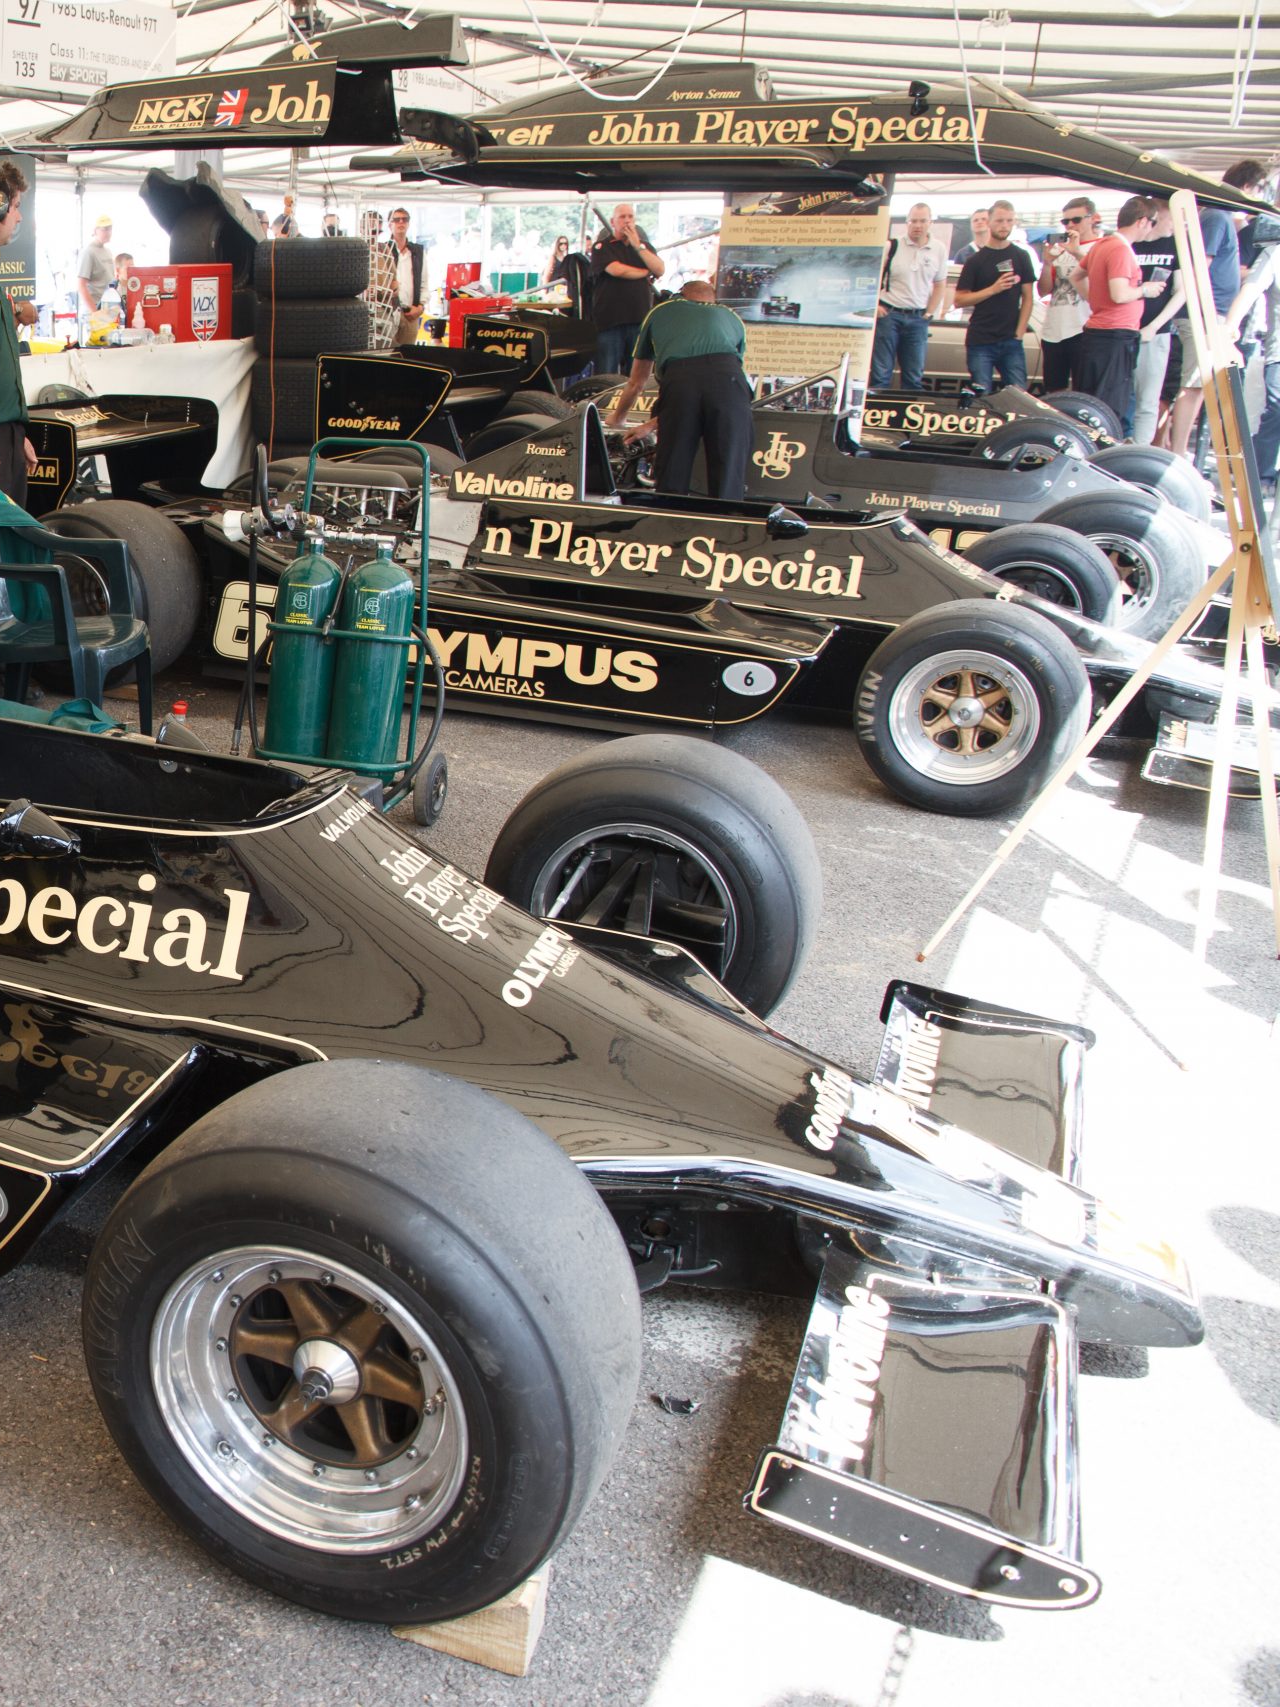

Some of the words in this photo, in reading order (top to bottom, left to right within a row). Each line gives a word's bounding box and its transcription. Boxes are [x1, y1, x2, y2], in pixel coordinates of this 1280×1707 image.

[50, 3, 77, 18] 1985
[80, 7, 141, 29] Lotus-Renault
[143, 16, 158, 33] 97T
[12, 50, 38, 61] SHELTER
[49, 43, 74, 58] Class
[15, 61, 36, 78] 135
[51, 64, 66, 82] sky
[69, 67, 107, 85] SPORTS
[666, 91, 704, 102] Ayrton
[705, 88, 741, 99] Senna
[137, 97, 207, 124] NGK
[132, 123, 165, 131] SPARK
[507, 124, 555, 146] elf
[587, 113, 680, 145] John
[689, 110, 819, 147] Player
[826, 106, 990, 152] Special
[476, 328, 535, 340] GOODYEAR
[54, 404, 110, 425] Special
[327, 415, 401, 432] GOODYEAR
[862, 408, 898, 429] er
[525, 443, 567, 457] Ronnie
[454, 471, 574, 501] Valvoline
[865, 491, 900, 507] John
[902, 494, 945, 511] Player
[946, 499, 1001, 518] Special
[324, 524, 354, 532] FOD
[481, 525, 512, 556] n
[523, 518, 672, 578] Player
[680, 536, 864, 599] Special
[444, 671, 545, 698] CAMERAS
[743, 671, 754, 687] 6
[379, 845, 433, 886] John
[404, 864, 468, 917] Player
[436, 880, 505, 945] Special
[501, 924, 574, 1008] OLYMPU
[894, 1017, 944, 1110] lvoline
[792, 1285, 891, 1461] Valvoline
